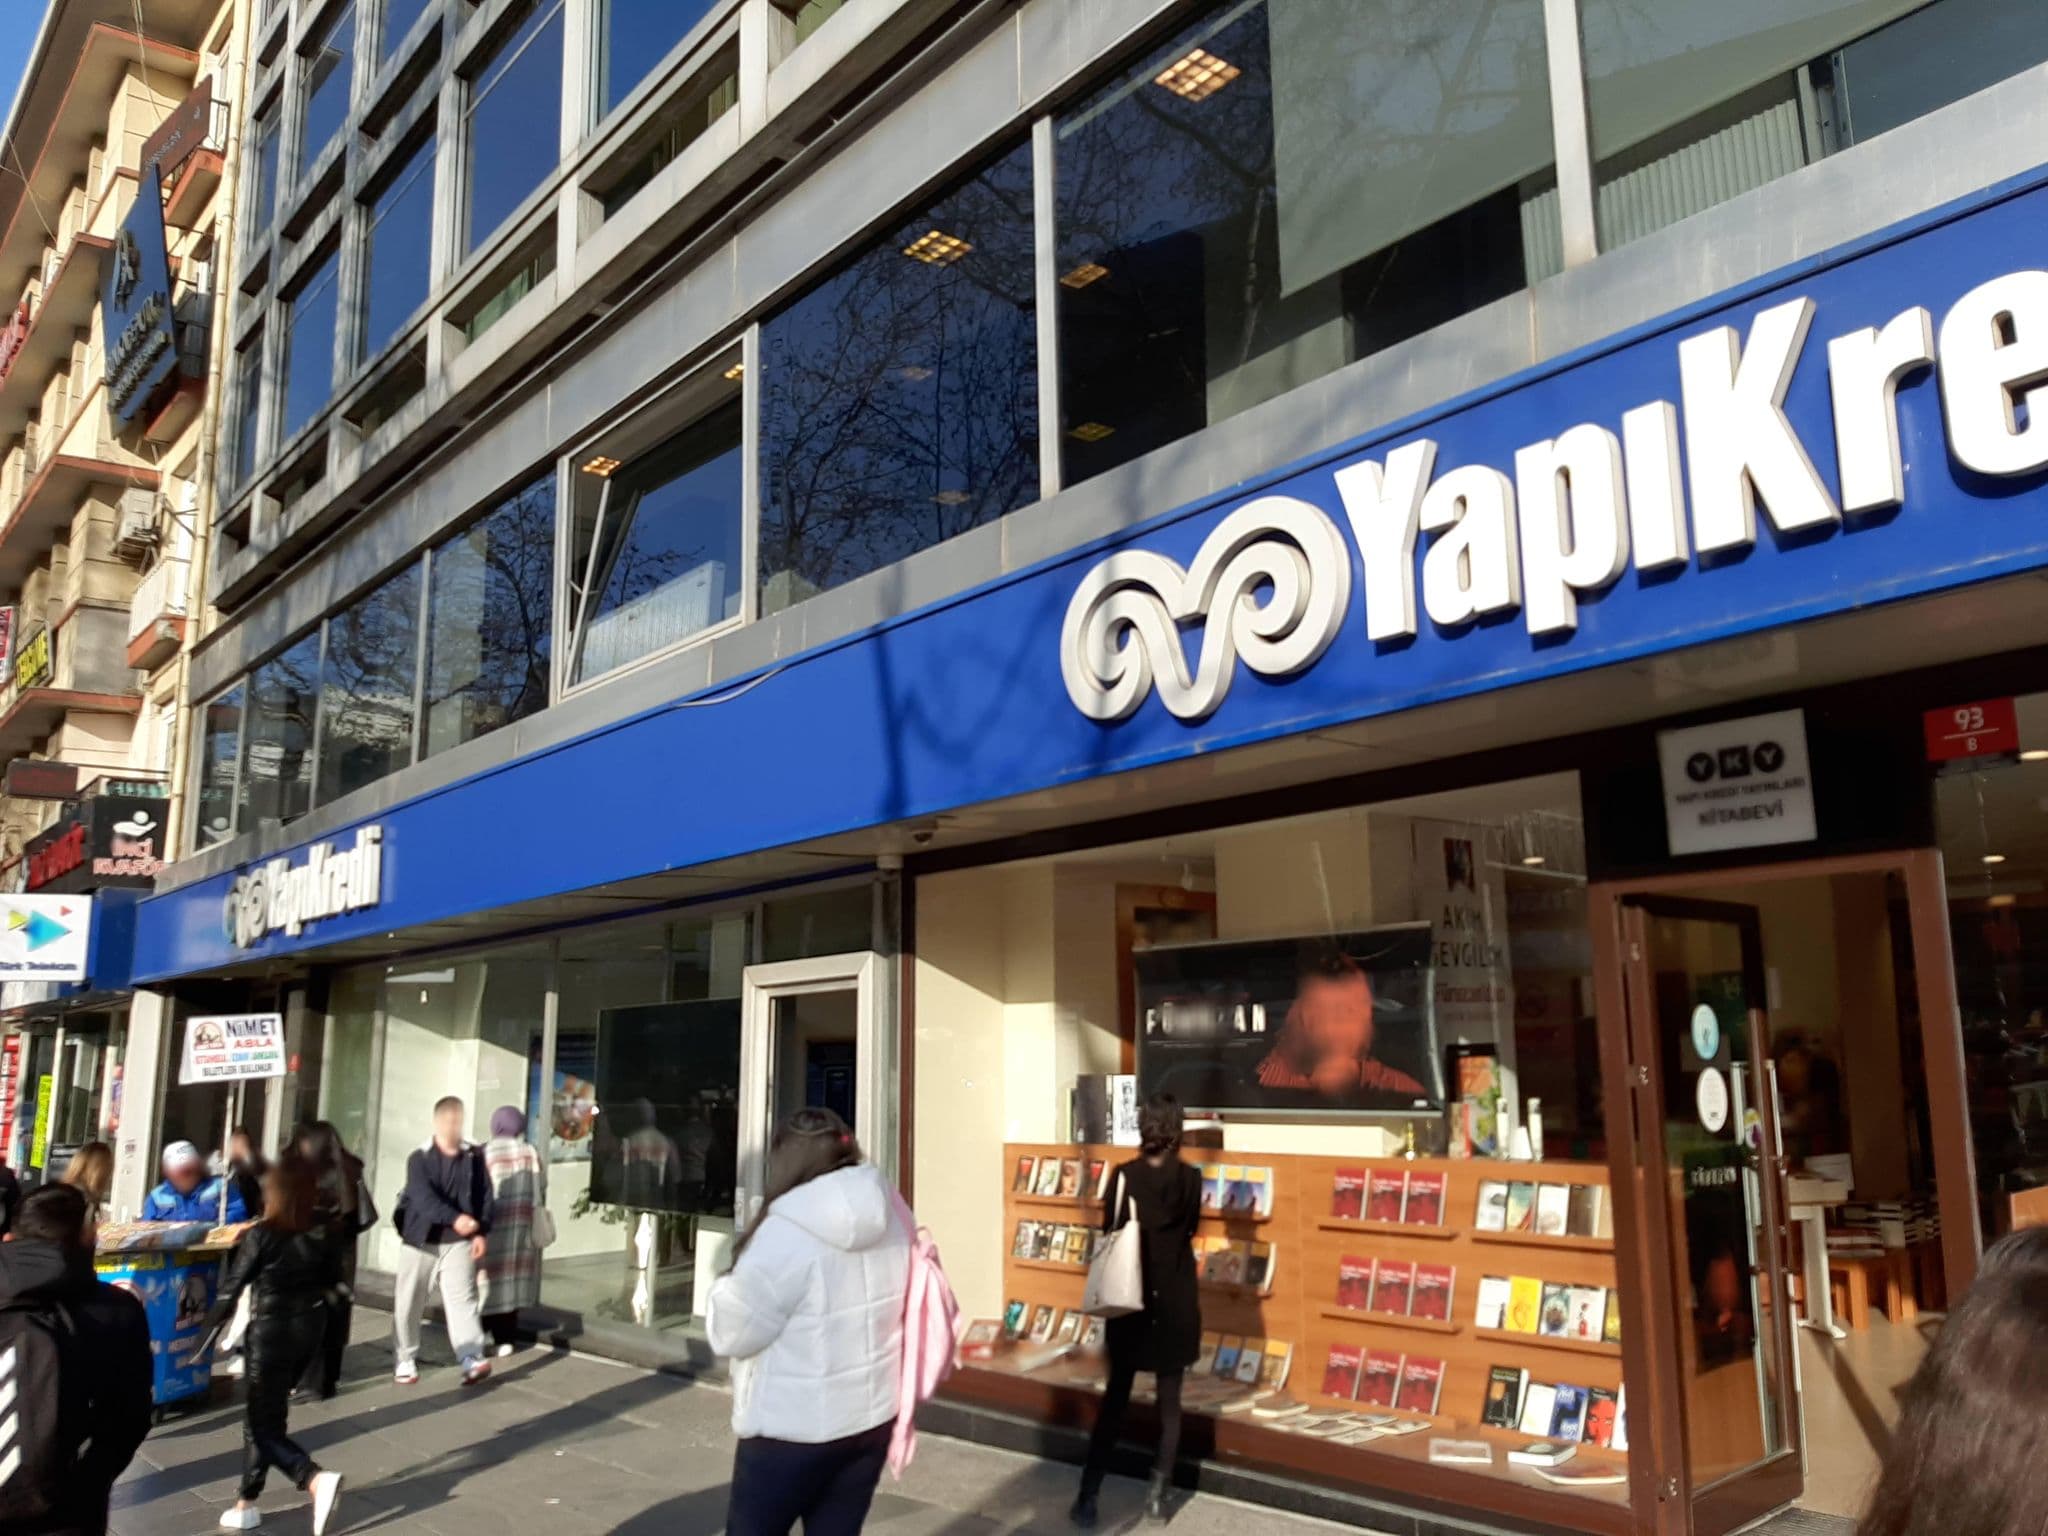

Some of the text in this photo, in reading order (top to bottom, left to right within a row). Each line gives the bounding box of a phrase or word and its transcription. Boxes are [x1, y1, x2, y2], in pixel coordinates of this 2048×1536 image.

[1955, 706, 1985, 731] 93
[1689, 744, 1782, 779] YKY
[1698, 798, 1785, 825] KİTABEVİ
[234, 1039, 274, 1049] ABLA
